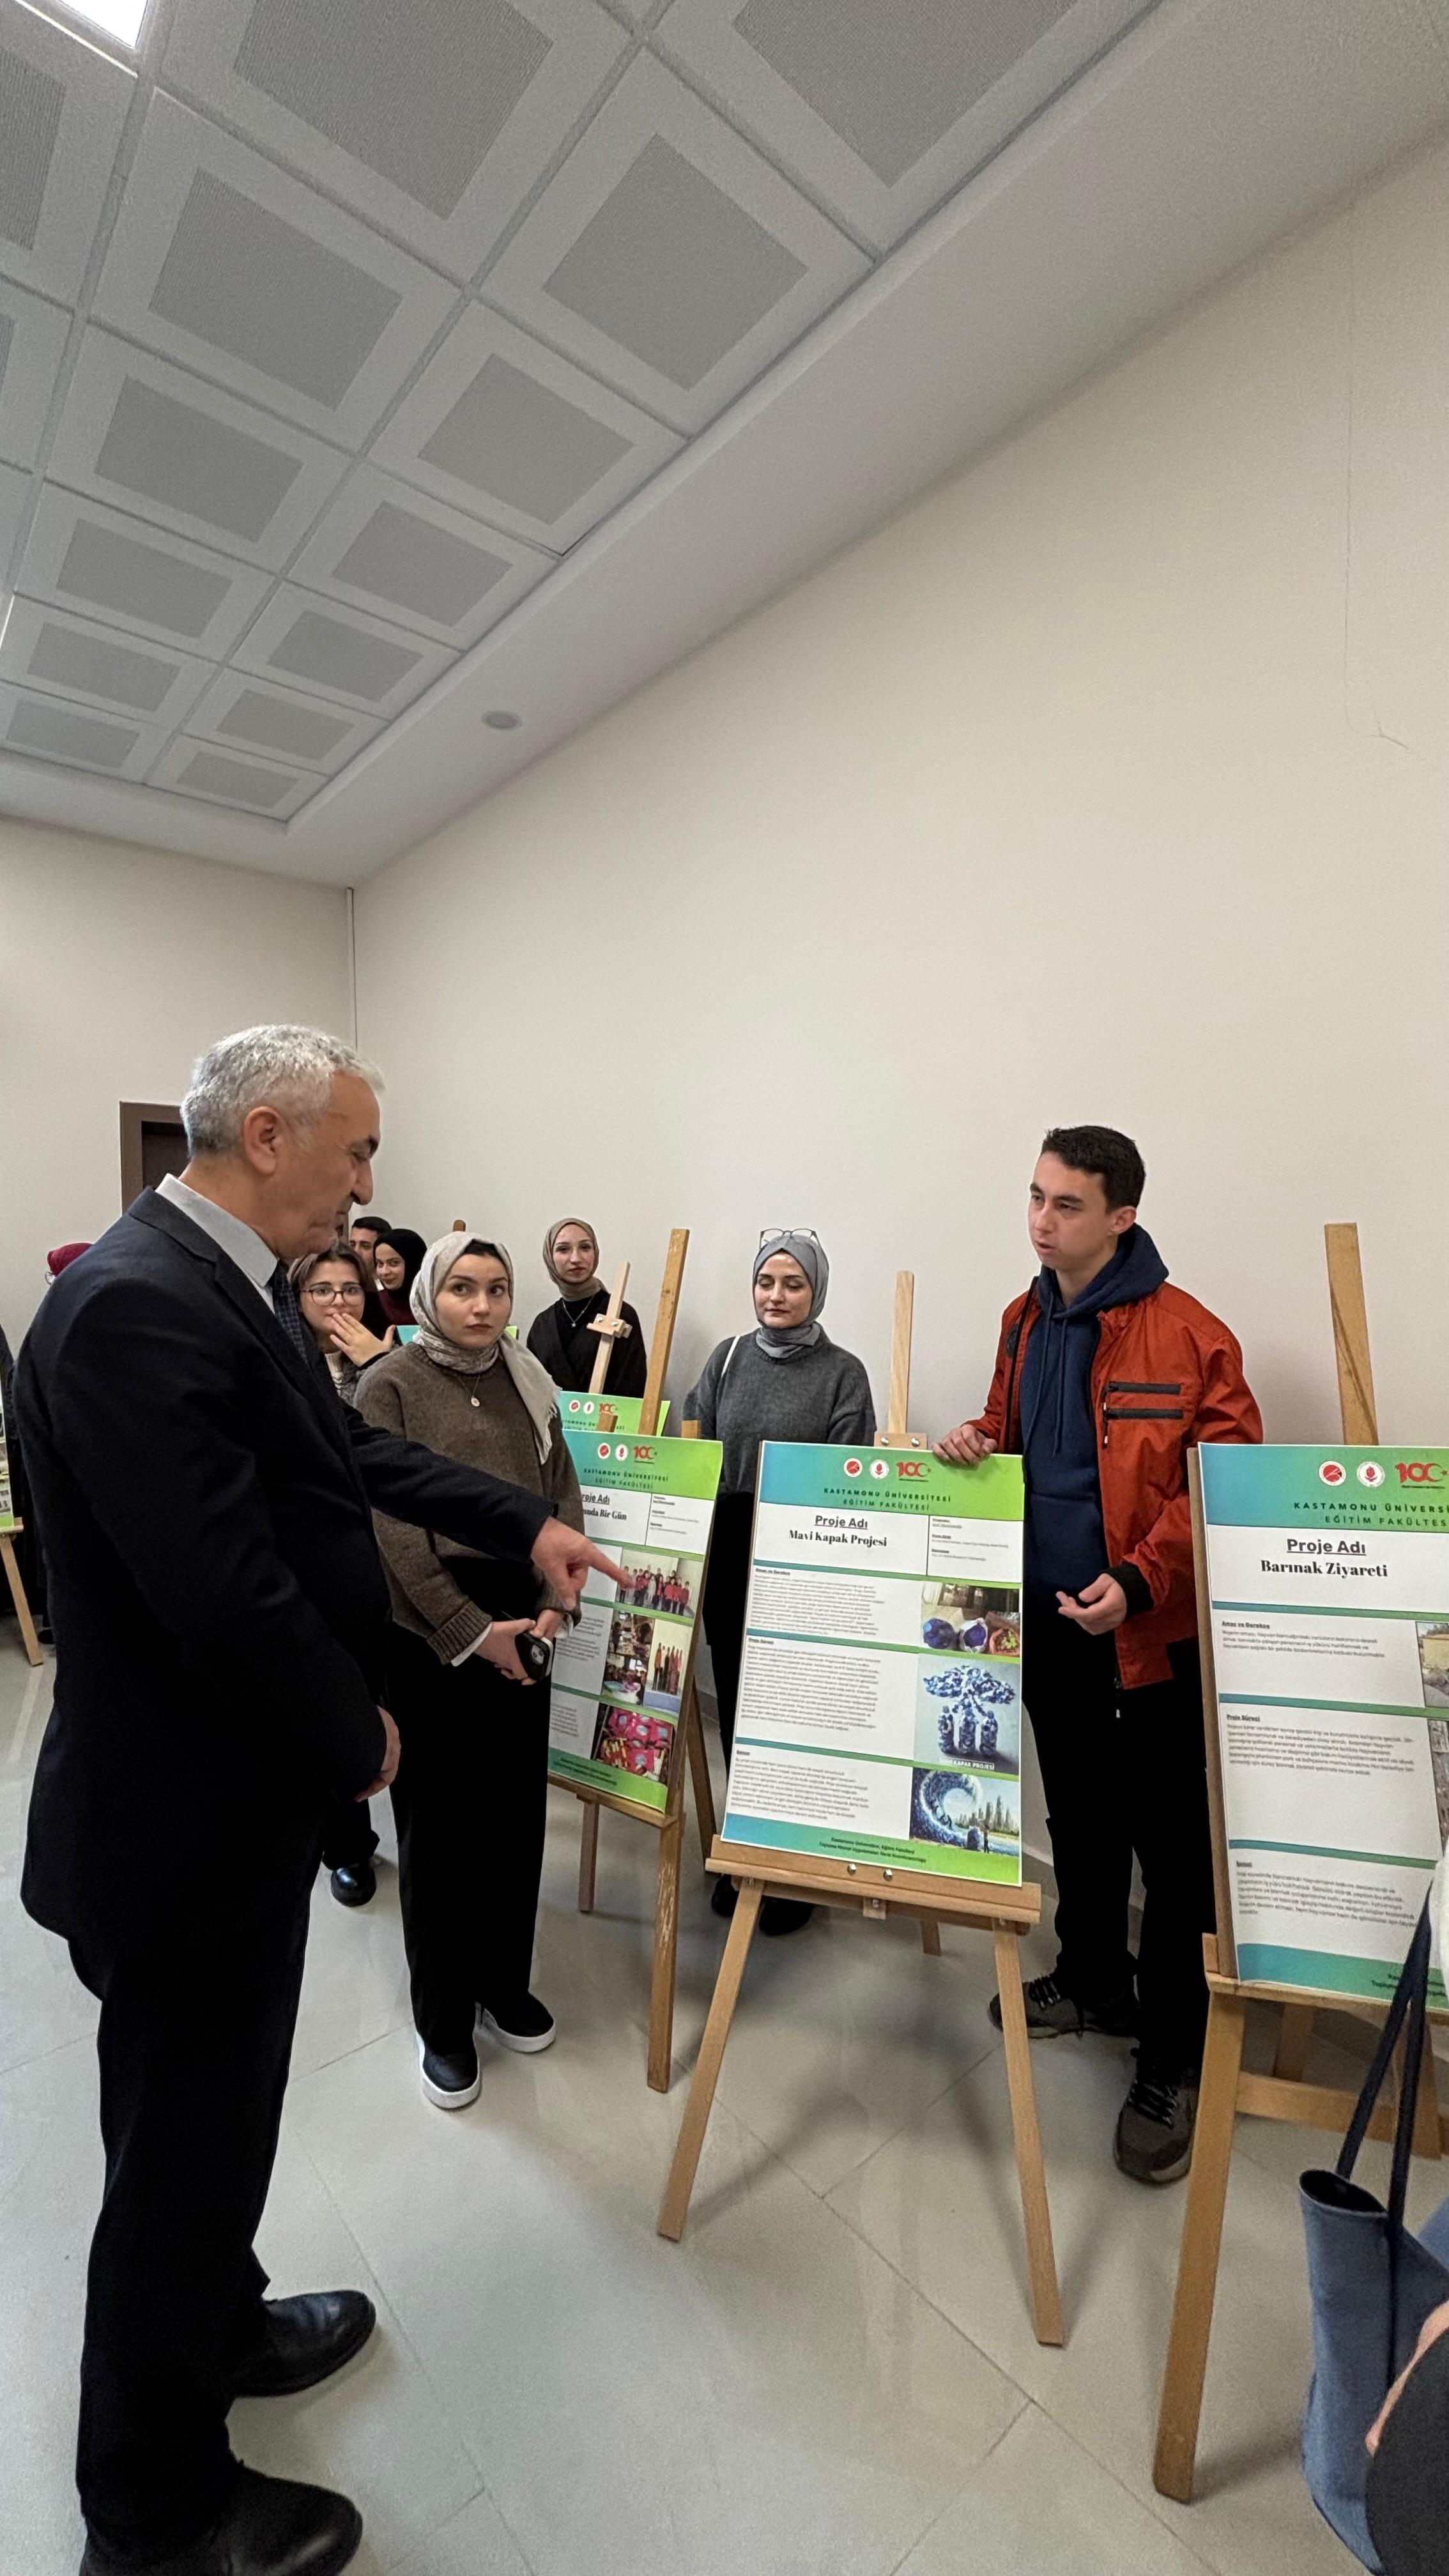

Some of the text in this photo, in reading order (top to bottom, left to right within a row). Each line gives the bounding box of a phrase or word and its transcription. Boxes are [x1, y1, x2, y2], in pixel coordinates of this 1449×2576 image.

[584, 1468, 620, 1476] KASTAMONU
[582, 1493, 610, 1505] roje Adı
[824, 1487, 951, 1503] KASTAMONU ÜNİVERSİTESİ
[843, 1498, 930, 1511] EĞİTİM FAKÜLTESİ
[1294, 1502, 1377, 1512] KASTAMONU
[600, 1508, 611, 1519] Bir
[612, 1511, 627, 1521] Gün
[1325, 1515, 1446, 1527] EĞİTİM FAKÜLTES
[815, 1515, 868, 1529] Proje Adı
[788, 1529, 887, 1548] Mavi Kapak Projesi
[1287, 1538, 1367, 1556] Proje Adı
[1261, 1560, 1388, 1579] Barınak Ziyareti
